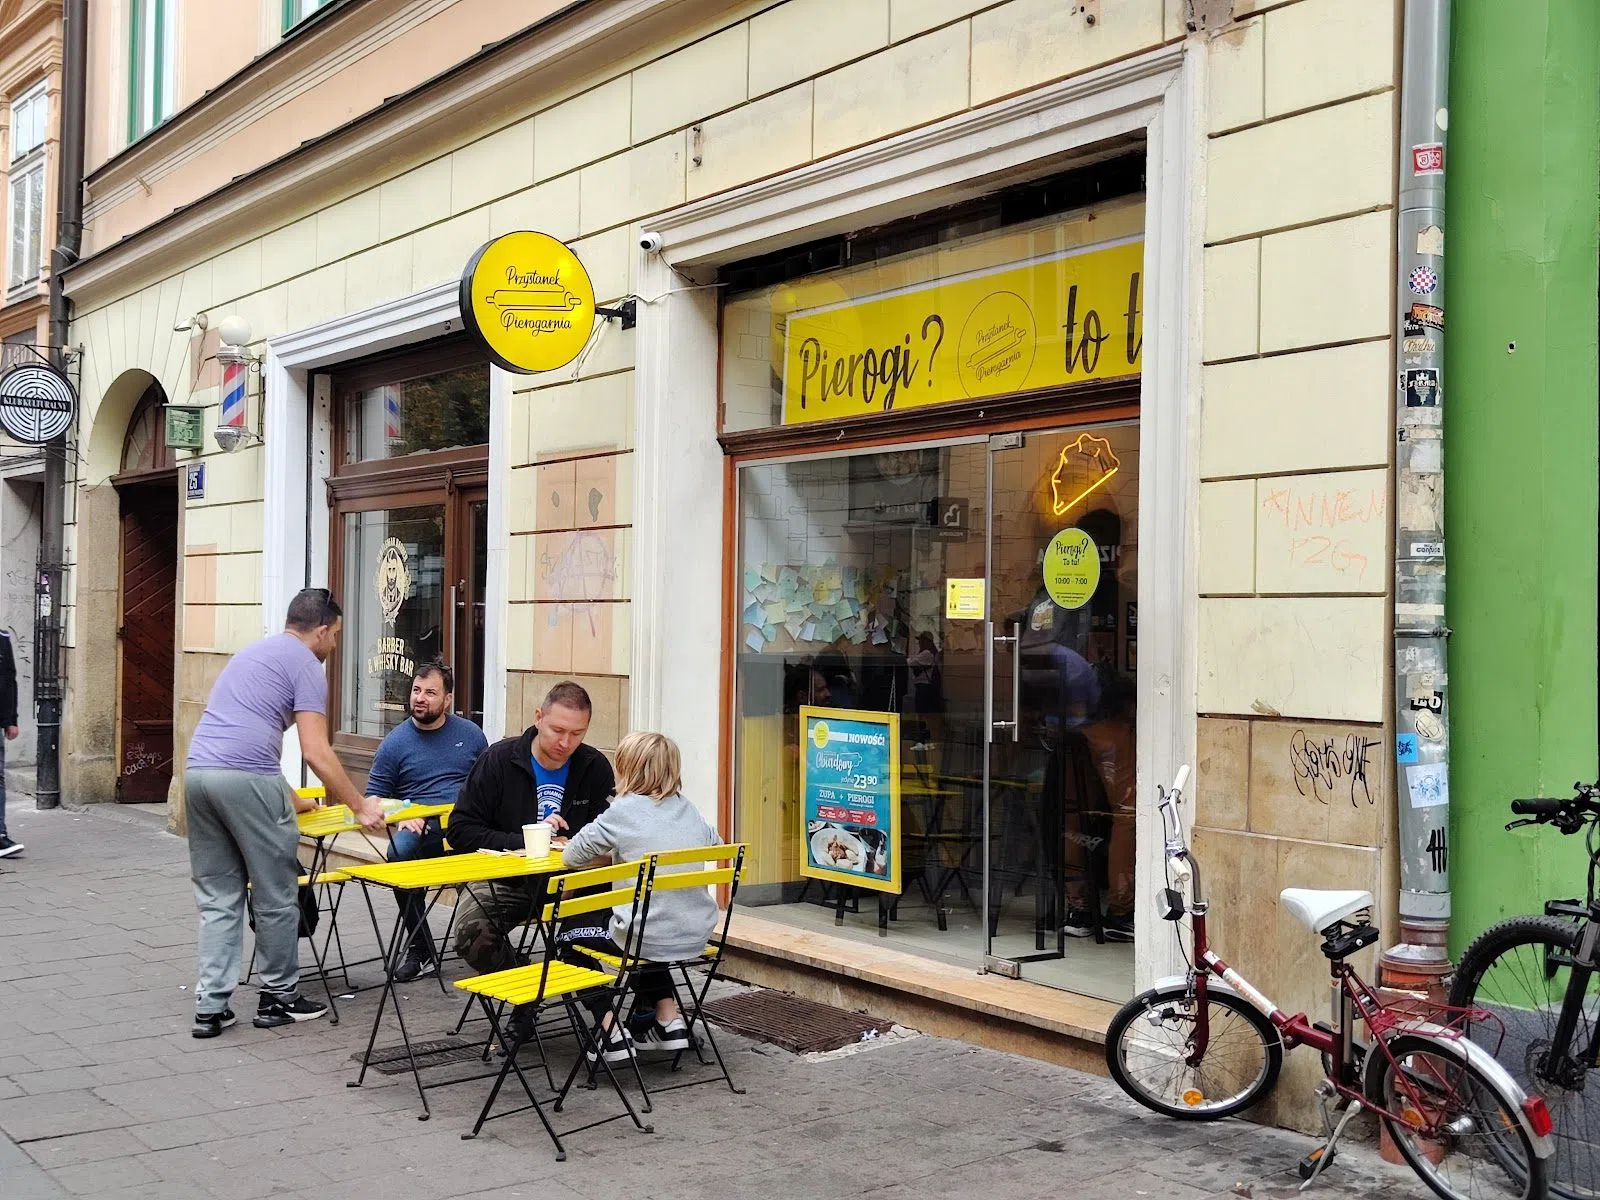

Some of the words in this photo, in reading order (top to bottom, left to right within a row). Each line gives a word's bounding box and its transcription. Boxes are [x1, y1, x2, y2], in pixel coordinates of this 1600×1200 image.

[504, 265, 565, 289] Przystanek
[500, 311, 573, 338] Pierogarnia
[1062, 284, 1110, 375] to
[975, 350, 1022, 383] Pierogarnia
[23, 399, 67, 410] KULTURALNY
[188, 472, 198, 490] 25
[1055, 538, 1089, 559] Pierogi?
[1062, 558, 1071, 566] To
[1055, 577, 1071, 585] 10:00
[1075, 577, 1088, 585] 7:00
[377, 636, 405, 656] BARBER
[367, 658, 374, 674] &
[373, 653, 400, 673] WHISKY
[399, 656, 415, 678] BAR
[848, 732, 885, 747] NOWOŚĆ!
[819, 789, 836, 800] ZUPA
[847, 792, 875, 805] PIEROGI
